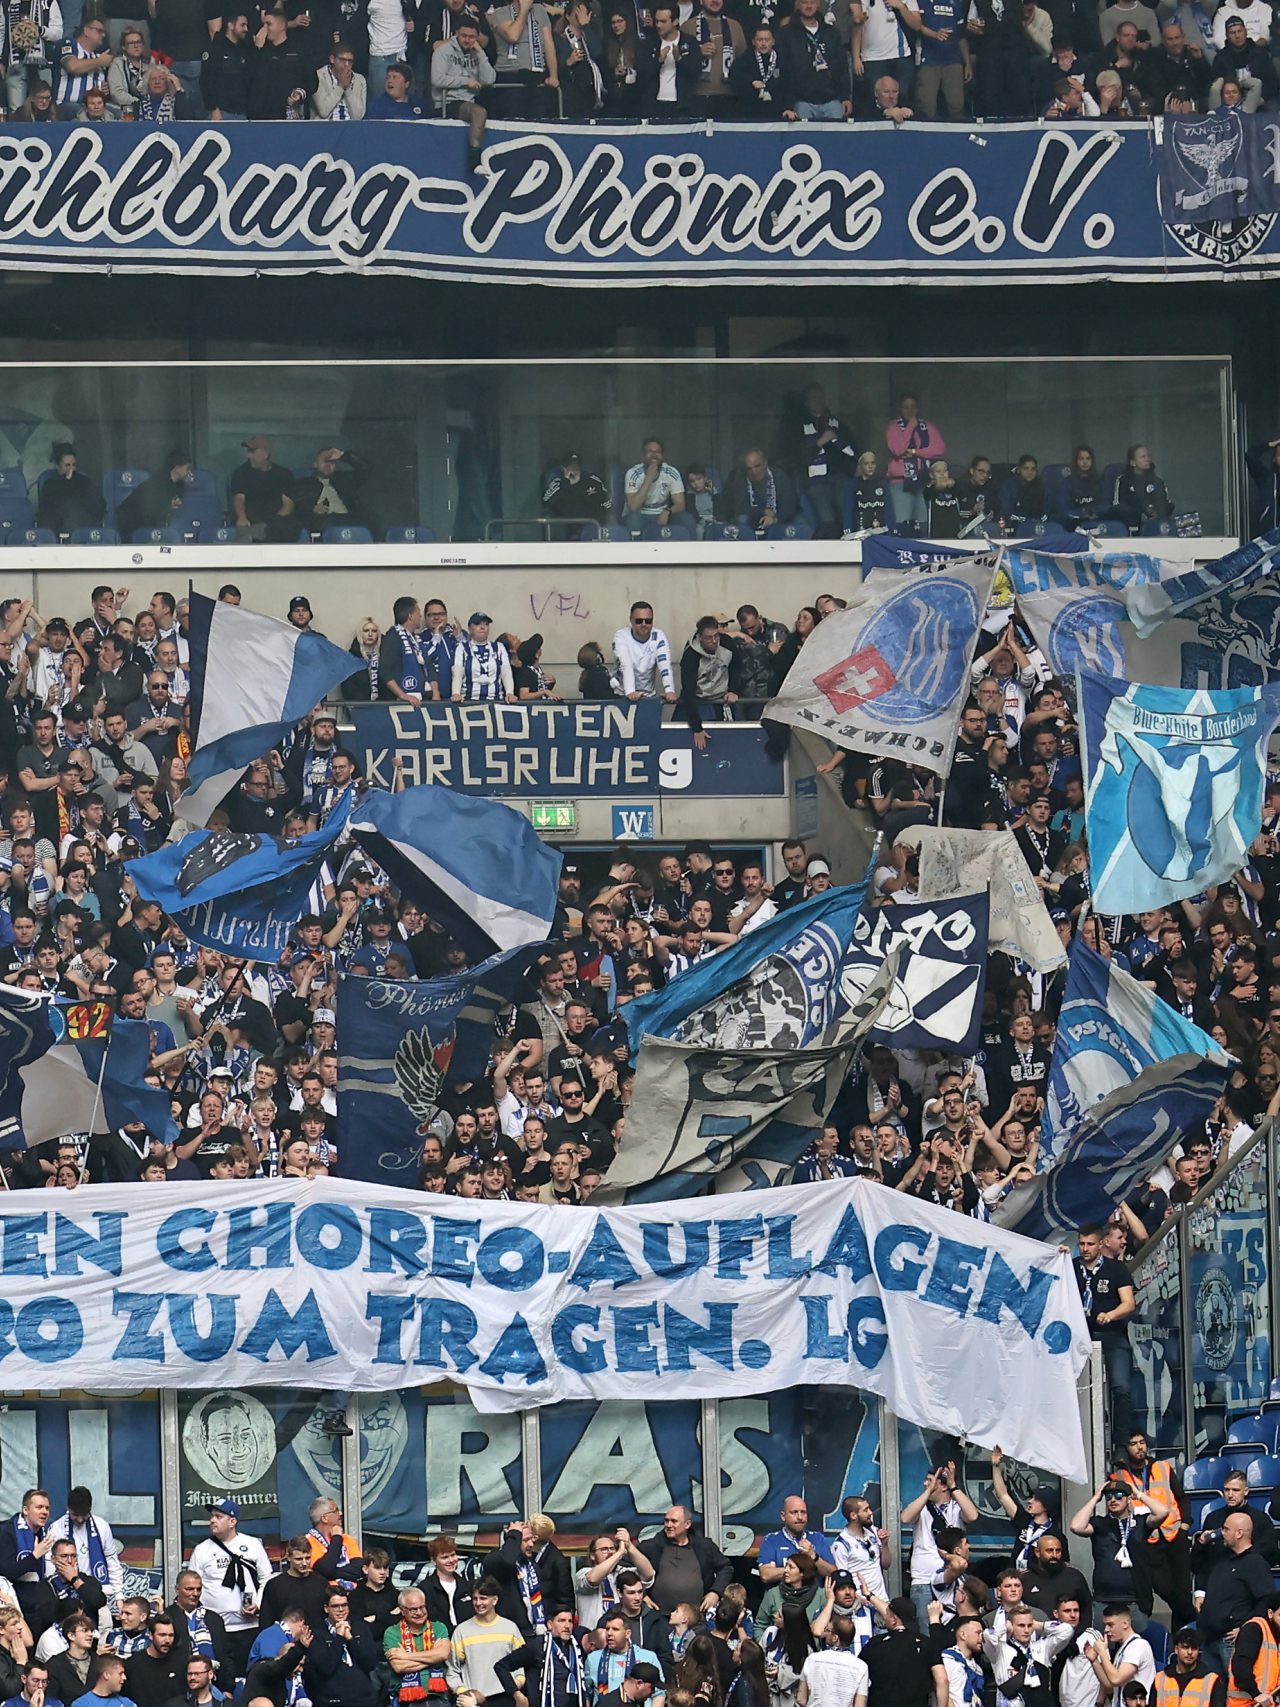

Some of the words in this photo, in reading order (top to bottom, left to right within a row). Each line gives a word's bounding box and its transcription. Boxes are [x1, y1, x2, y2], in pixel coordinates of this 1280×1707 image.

[909, 129, 1116, 253] e.V.
[388, 704, 637, 742] CHAOTEN
[365, 744, 650, 788] KARLSRUHE
[66, 1001, 109, 1039] 92
[156, 1199, 1072, 1355] CHOREO-AUFLAGEN.
[112, 1287, 338, 1365] ZUM
[365, 1292, 772, 1385] TRAGEN.
[799, 1294, 890, 1370] LG
